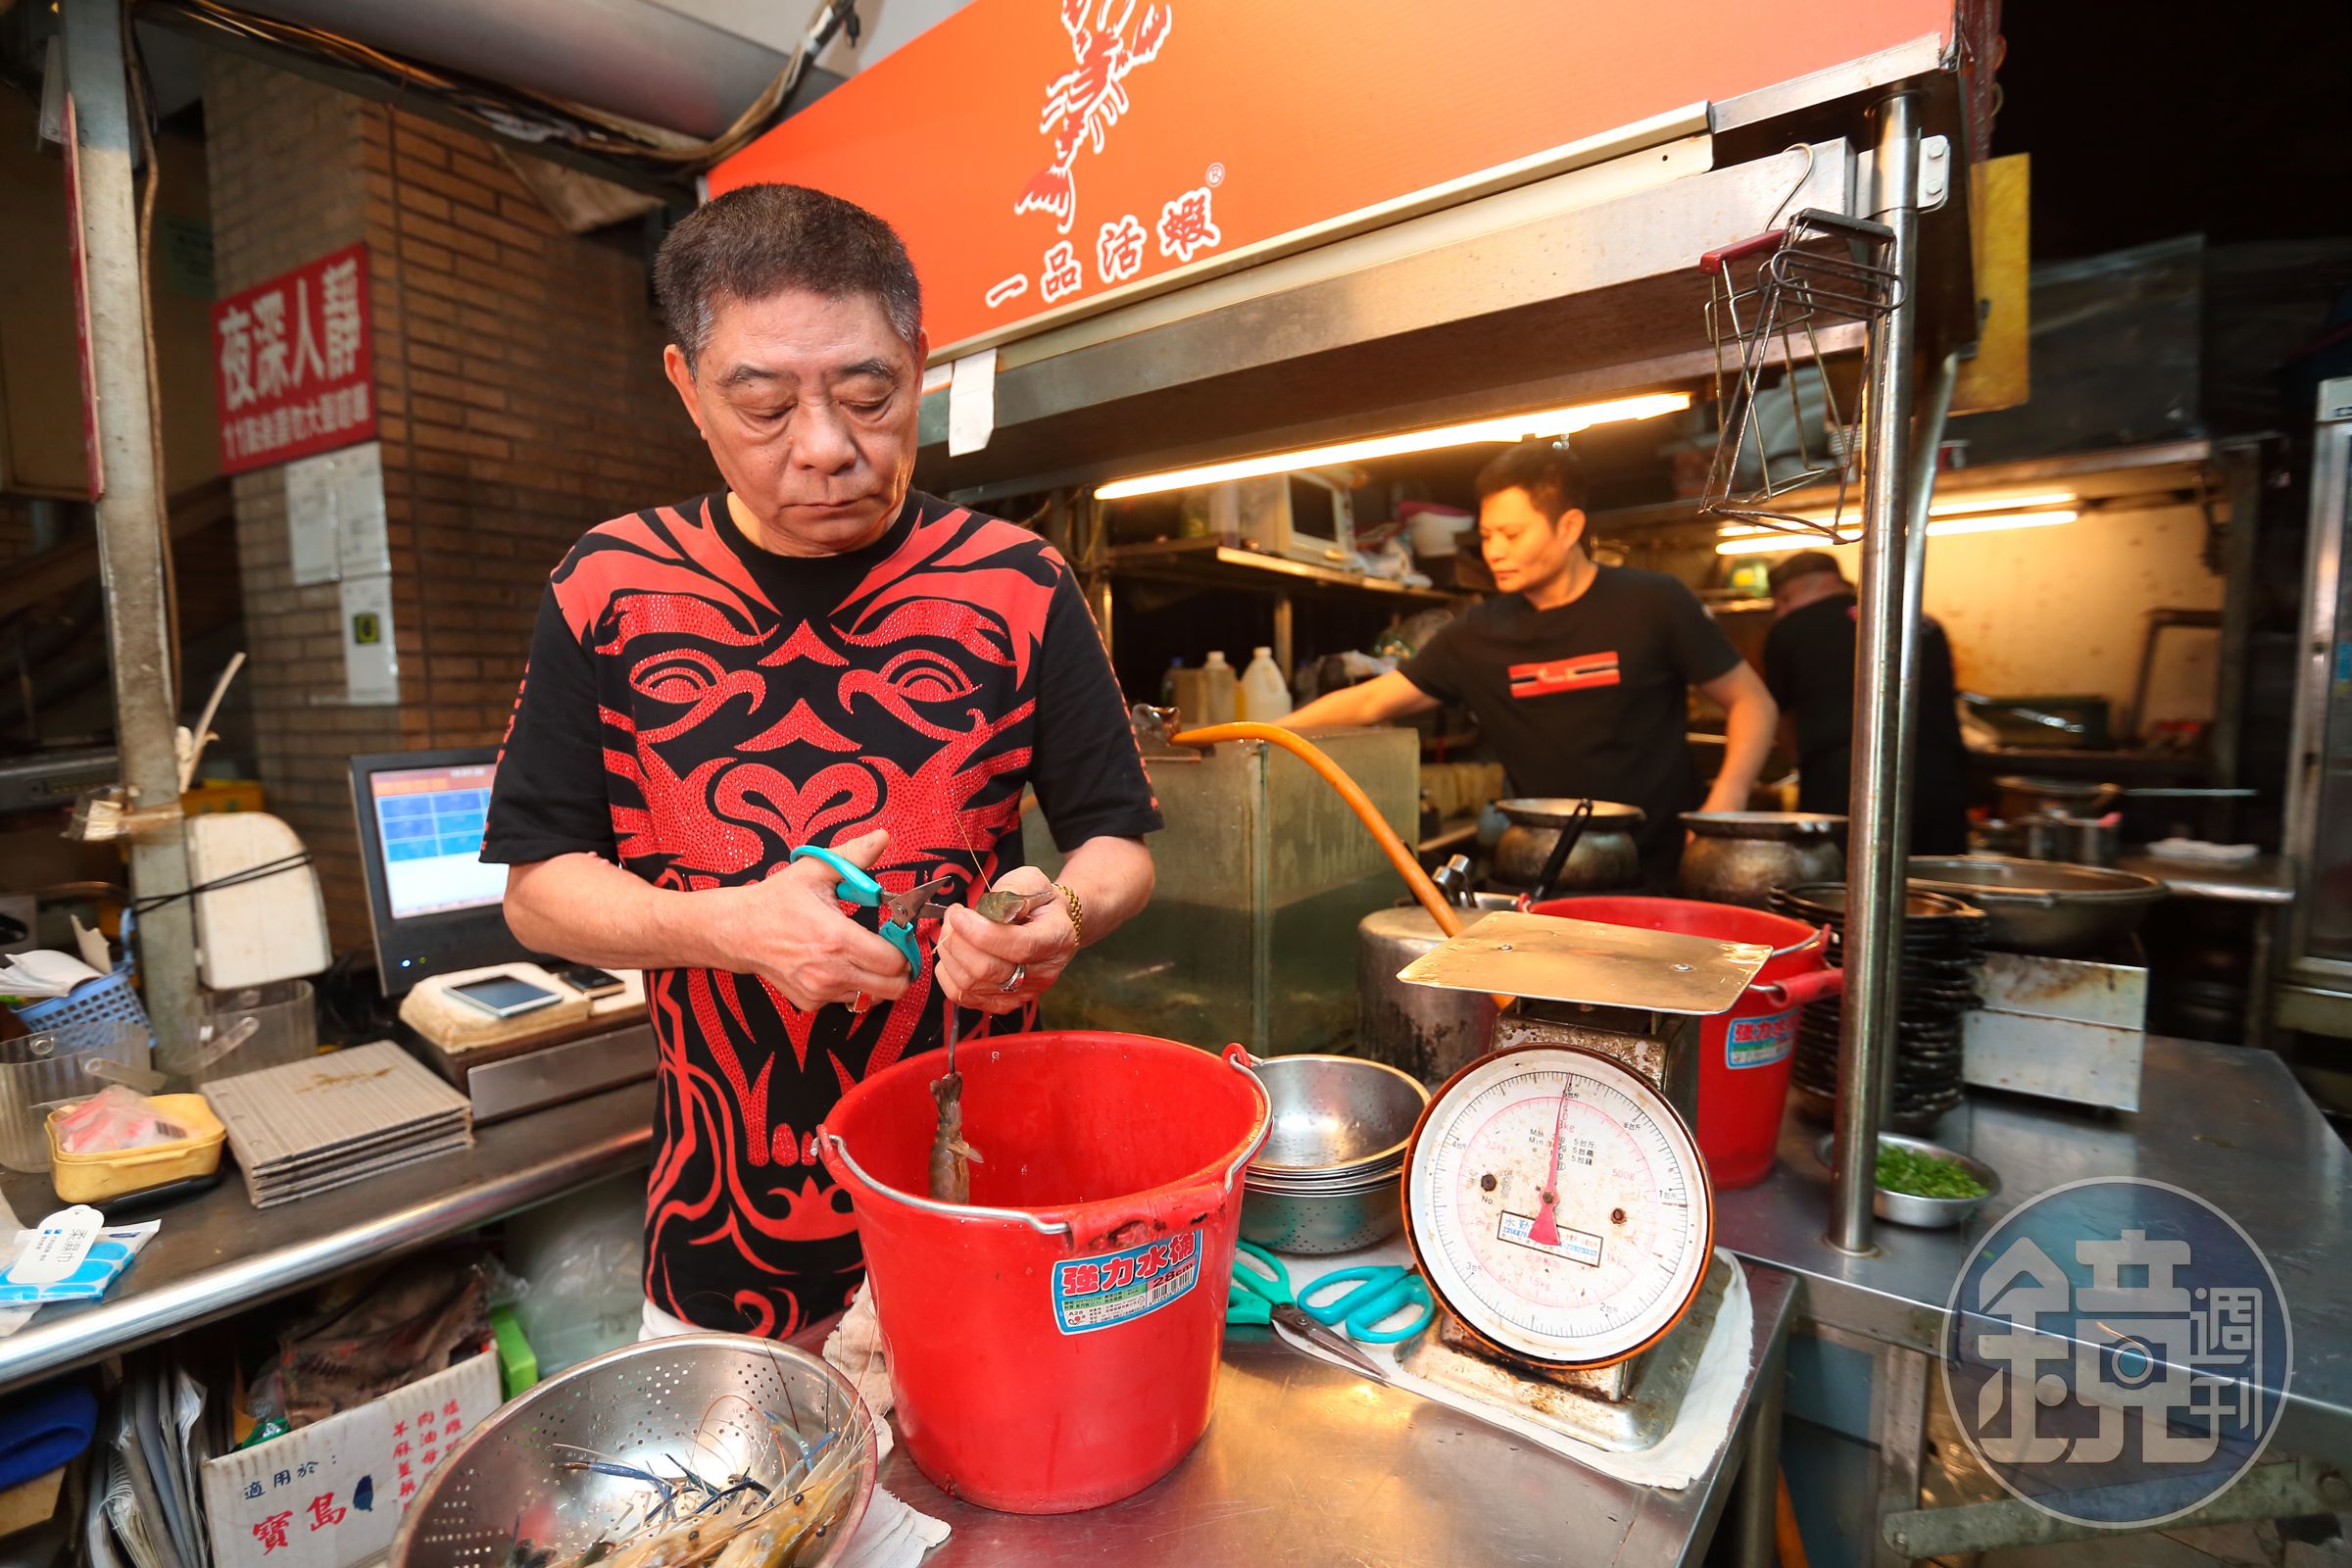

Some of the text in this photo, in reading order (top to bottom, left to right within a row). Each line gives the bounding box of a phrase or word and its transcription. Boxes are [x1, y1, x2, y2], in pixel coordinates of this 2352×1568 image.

[986, 187, 1221, 308] 一品活蝦
[1061, 1232, 1196, 1297] 強力水桶
[1152, 1262, 1194, 1289] 28cm
[252, 1492, 346, 1556] 寶島
